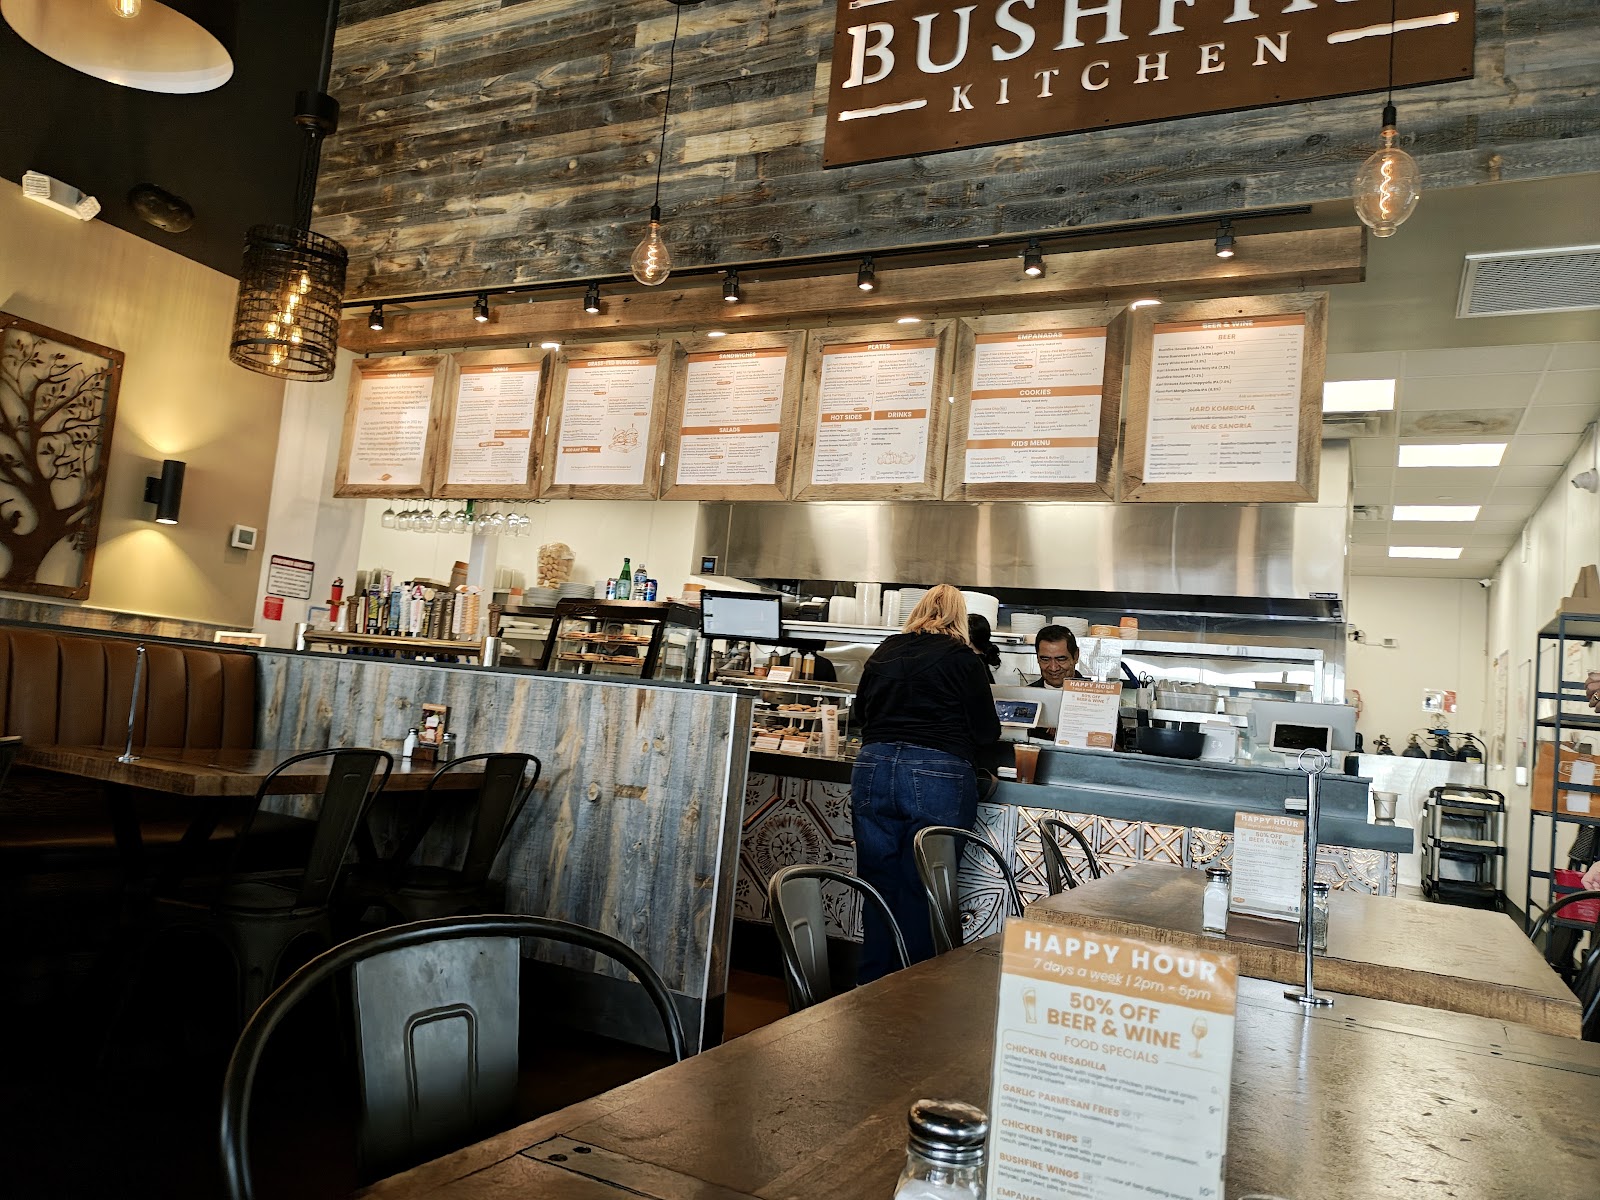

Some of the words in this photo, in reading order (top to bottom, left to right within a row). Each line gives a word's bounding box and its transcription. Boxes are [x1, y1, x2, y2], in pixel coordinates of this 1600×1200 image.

[949, 31, 1291, 113] KITCHEN
[1018, 332, 1063, 340] EMPANADAS
[1241, 814, 1271, 824] HAPPY
[1274, 818, 1299, 828] HOUR
[1024, 930, 1120, 964] HAPPY
[1132, 949, 1218, 982] HOUR
[1033, 958, 1041, 969] 7
[1043, 960, 1074, 977] days
[1077, 968, 1086, 977] a
[1090, 970, 1122, 986] week
[1134, 976, 1165, 993] 2pm
[1178, 985, 1212, 1002] 5pm
[1069, 992, 1114, 1016] 50%
[1119, 1002, 1161, 1025] OFF
[1047, 1008, 1096, 1033] BEER
[1102, 1021, 1117, 1038] &
[1123, 1023, 1182, 1050] WINE
[1006, 1043, 1047, 1058] CHICKEN
[1049, 1052, 1106, 1071] QUESADILLA
[1064, 1036, 1098, 1051] FOOD
[1102, 1044, 1159, 1064] SPECIALS
[1002, 1084, 1036, 1097] GARLIC
[1038, 1091, 1090, 1110] PARMESAN
[1092, 1104, 1120, 1118] FRIES
[1001, 1118, 1043, 1135] CHICKEN
[1046, 1129, 1078, 1143] STRIPS
[1000, 1152, 1043, 1170] BUSHFIRE
[1046, 1164, 1079, 1179] WINGS
